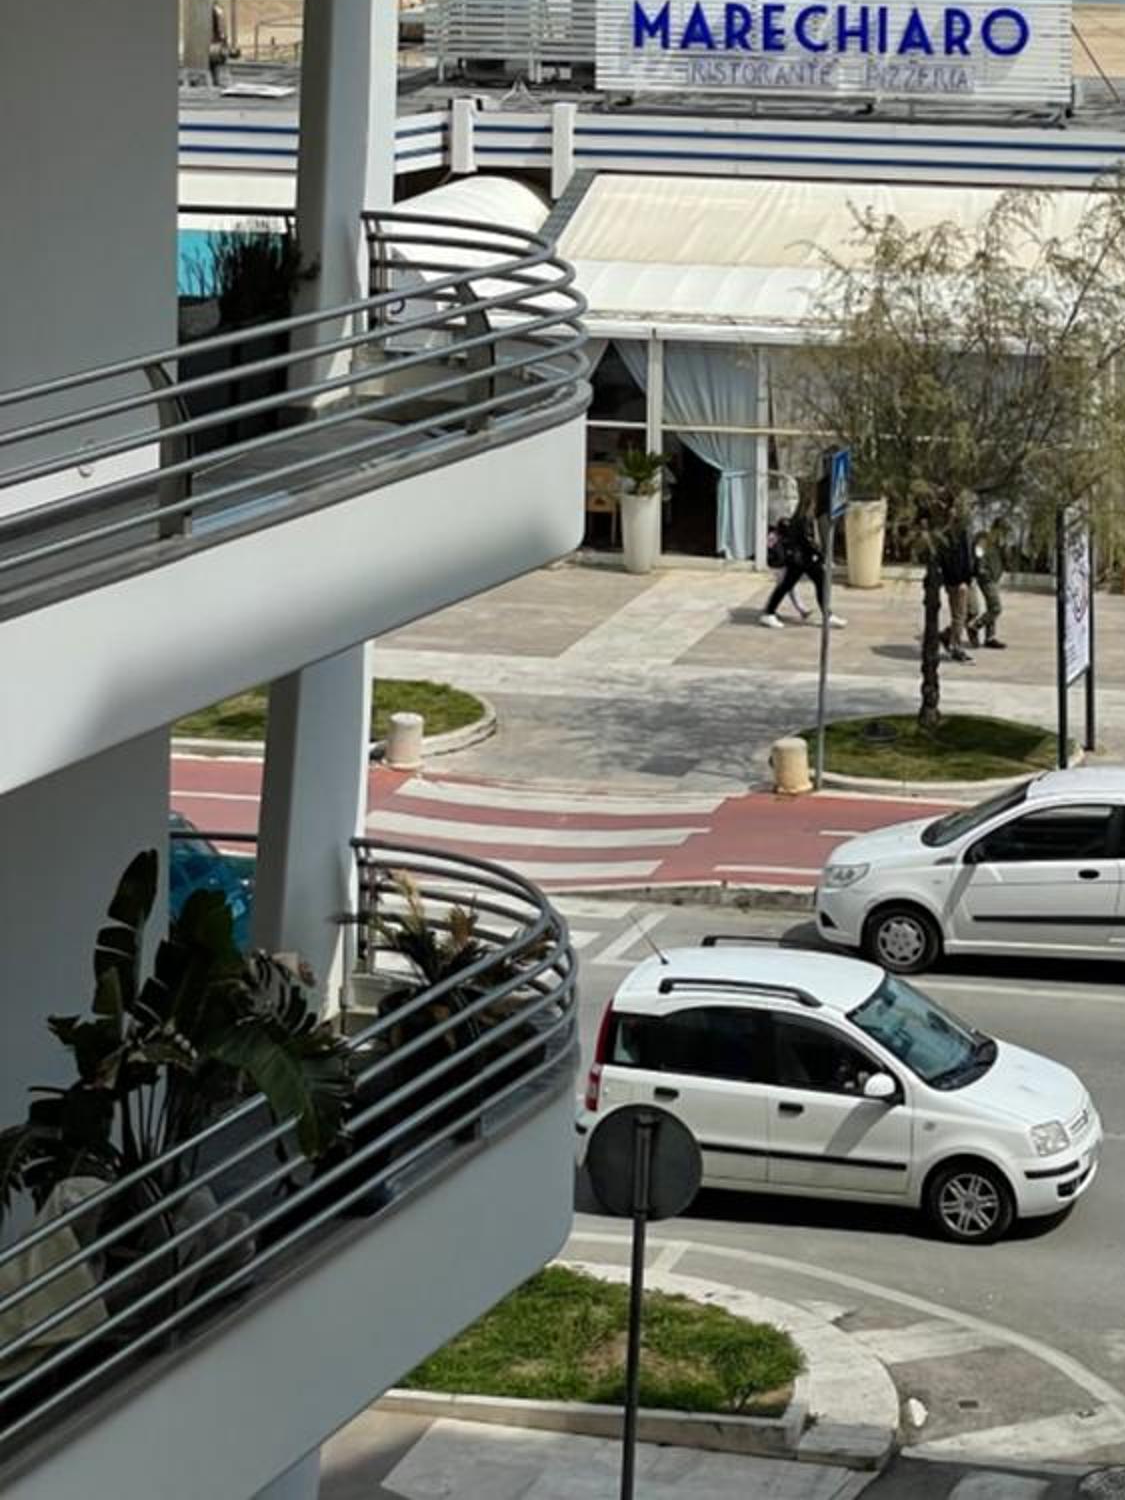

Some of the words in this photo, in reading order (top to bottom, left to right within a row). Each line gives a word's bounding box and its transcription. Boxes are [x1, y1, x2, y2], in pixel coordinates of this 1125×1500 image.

[633, 0, 1030, 57] MARECHIARO
[690, 59, 832, 85] RISTORANTE
[866, 64, 970, 91] PIZZERIA
